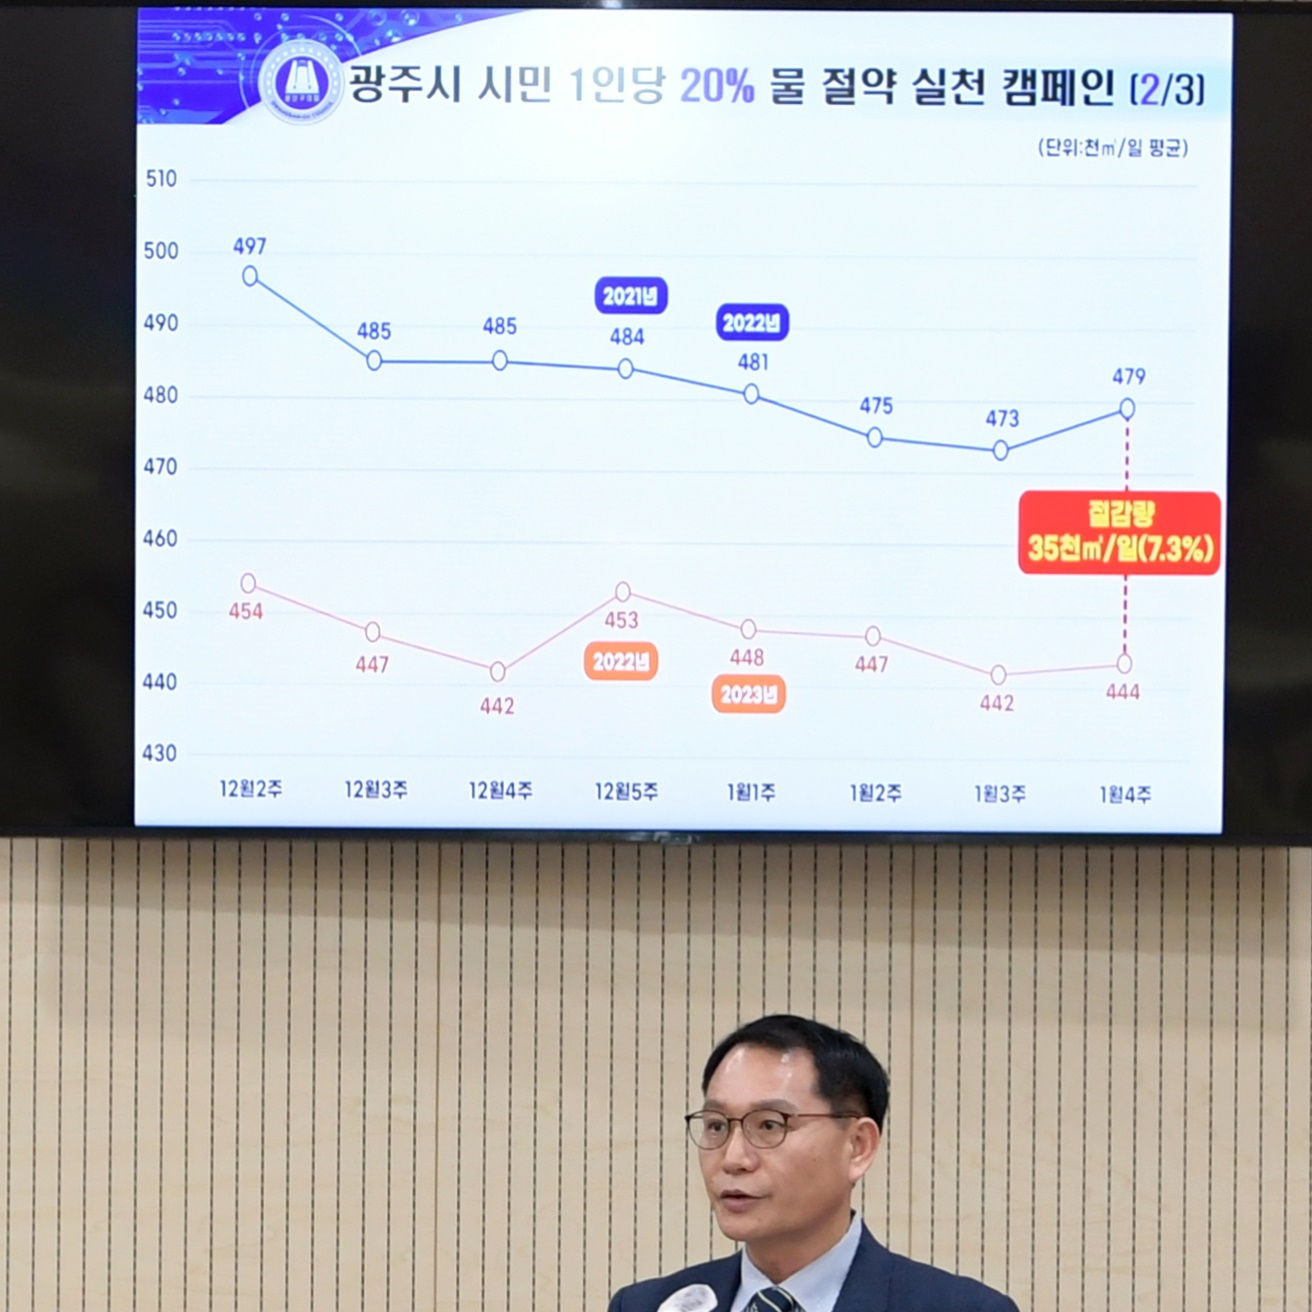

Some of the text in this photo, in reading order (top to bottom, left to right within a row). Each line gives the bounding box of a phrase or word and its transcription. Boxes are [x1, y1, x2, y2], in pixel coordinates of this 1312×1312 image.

[349, 65, 1205, 107] 광주시 시민 1인당 20% 물 절약 실천 캠페인 (2/3)
[1150, 138, 1189, 158] 평균)
[146, 169, 178, 188] 510
[144, 241, 179, 260] 500
[233, 237, 267, 256] 497
[603, 286, 658, 306] 2021년
[144, 313, 179, 332] 490
[357, 322, 392, 340] 485
[483, 317, 517, 336] 485
[723, 312, 781, 333] 2022년
[610, 327, 645, 346] 484
[738, 352, 769, 371] 481
[1113, 368, 1146, 386] 479
[144, 385, 179, 404] 480
[860, 397, 894, 415] 475
[986, 409, 1020, 428] 473
[144, 457, 178, 476] 470
[1089, 500, 1155, 528] 절감량
[143, 529, 178, 548] 460
[143, 601, 178, 620] 450
[229, 603, 264, 620] 454
[605, 611, 639, 629] 453
[355, 656, 389, 674] 447
[593, 651, 650, 672] 2022년
[730, 648, 764, 666] 448
[855, 656, 889, 673] 447
[143, 672, 178, 691] 440
[720, 684, 778, 705] 2023년
[1106, 683, 1141, 700] 444
[480, 697, 514, 715] 442
[980, 695, 1014, 712] 442
[142, 744, 177, 763] 430
[220, 779, 283, 799] 12월2주
[345, 779, 408, 800] 12월3주
[469, 780, 533, 801] 12월4주
[595, 782, 659, 802] 12월5주
[728, 782, 776, 803] 1월1주
[850, 783, 902, 803] 1월2주
[974, 784, 1026, 804] 1월3주
[1100, 785, 1152, 805] 1월4주
